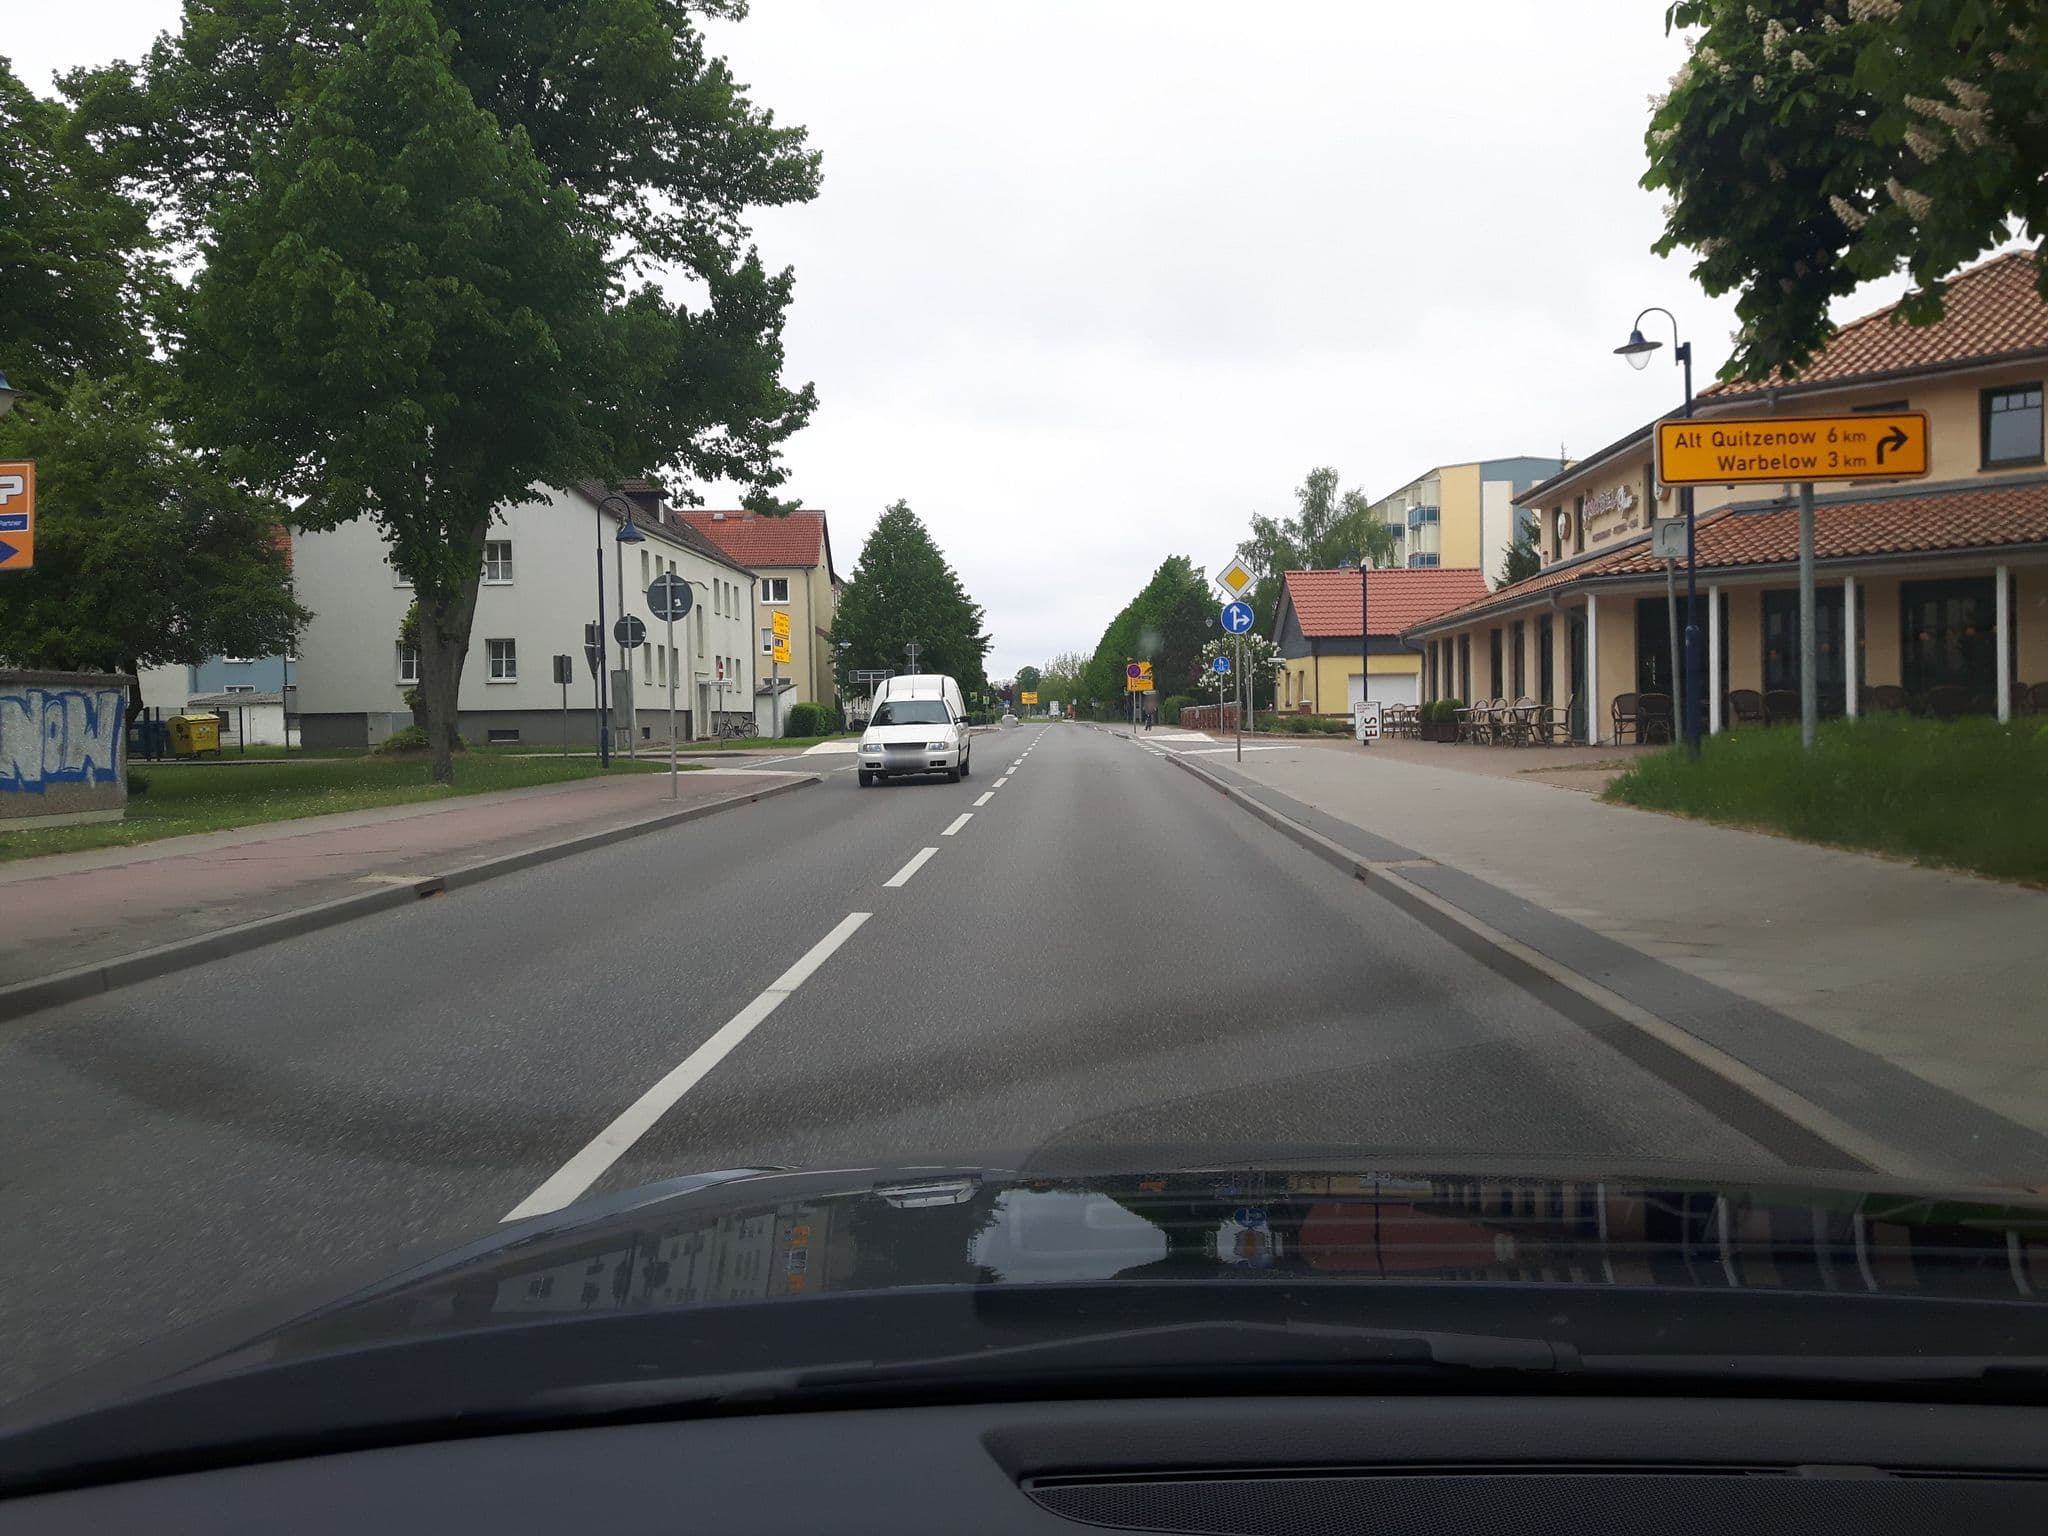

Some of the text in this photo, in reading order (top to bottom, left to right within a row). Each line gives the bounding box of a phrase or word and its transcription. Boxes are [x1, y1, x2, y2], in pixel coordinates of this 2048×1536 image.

[1675, 427, 1867, 448] Alt Quitzenow 6 km
[1717, 451, 1867, 472] Warbelow 3 km
[1364, 716, 1378, 737] EIS
